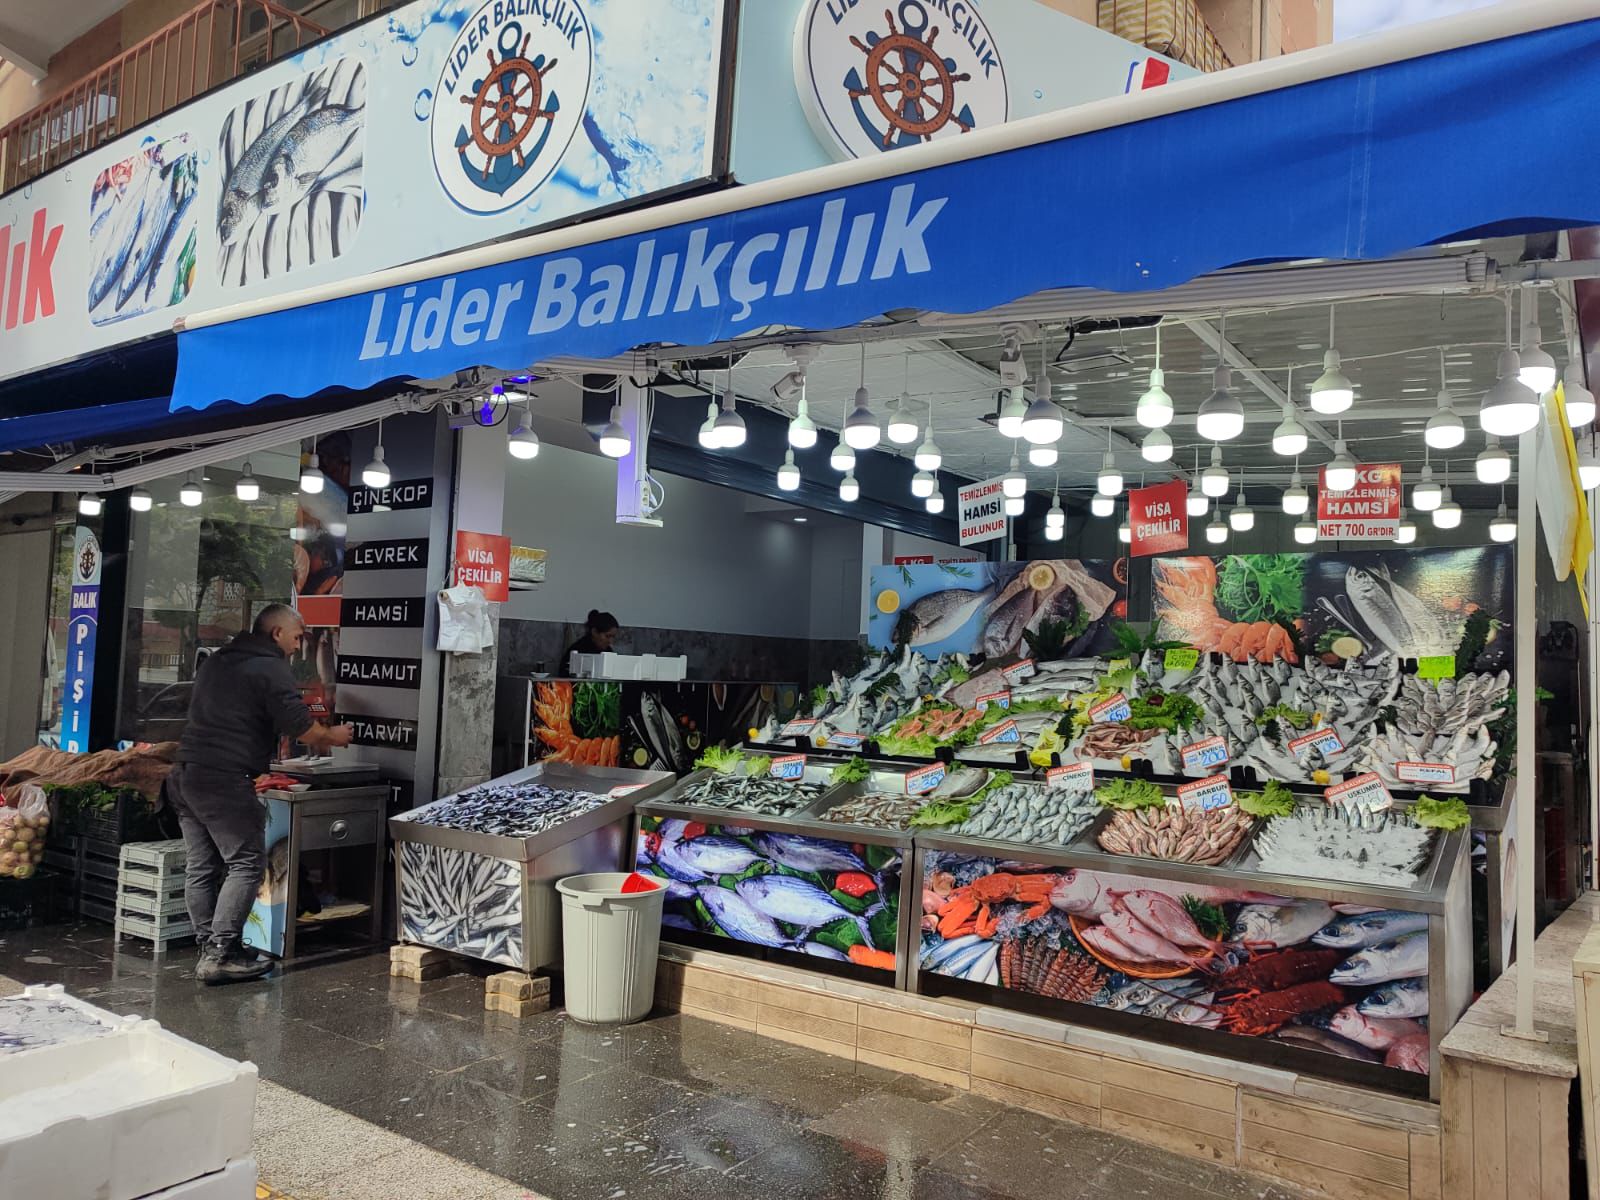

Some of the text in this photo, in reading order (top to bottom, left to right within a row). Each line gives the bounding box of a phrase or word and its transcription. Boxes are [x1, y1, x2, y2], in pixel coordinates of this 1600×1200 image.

[444, 0, 583, 95] LİDER BALIKÇILIK
[359, 183, 949, 360] Lider Balıkçılık
[353, 485, 427, 511] ÇİNEKOP
[1327, 499, 1389, 515] HAMSİ
[964, 498, 1001, 521] HAMSİ
[1145, 501, 1171, 518] VİSA
[962, 520, 1004, 538] BULUNUR
[1137, 516, 1181, 541] ÇEKİLİR
[1320, 524, 1341, 536] NET
[1345, 524, 1364, 536] 700
[354, 546, 419, 565] LEVREK
[468, 547, 494, 565] VİSA
[72, 591, 97, 609] BALIK
[355, 601, 408, 621] HAMSİ
[340, 662, 417, 681] PALAMUT
[1197, 785, 1228, 797] BARBUN
